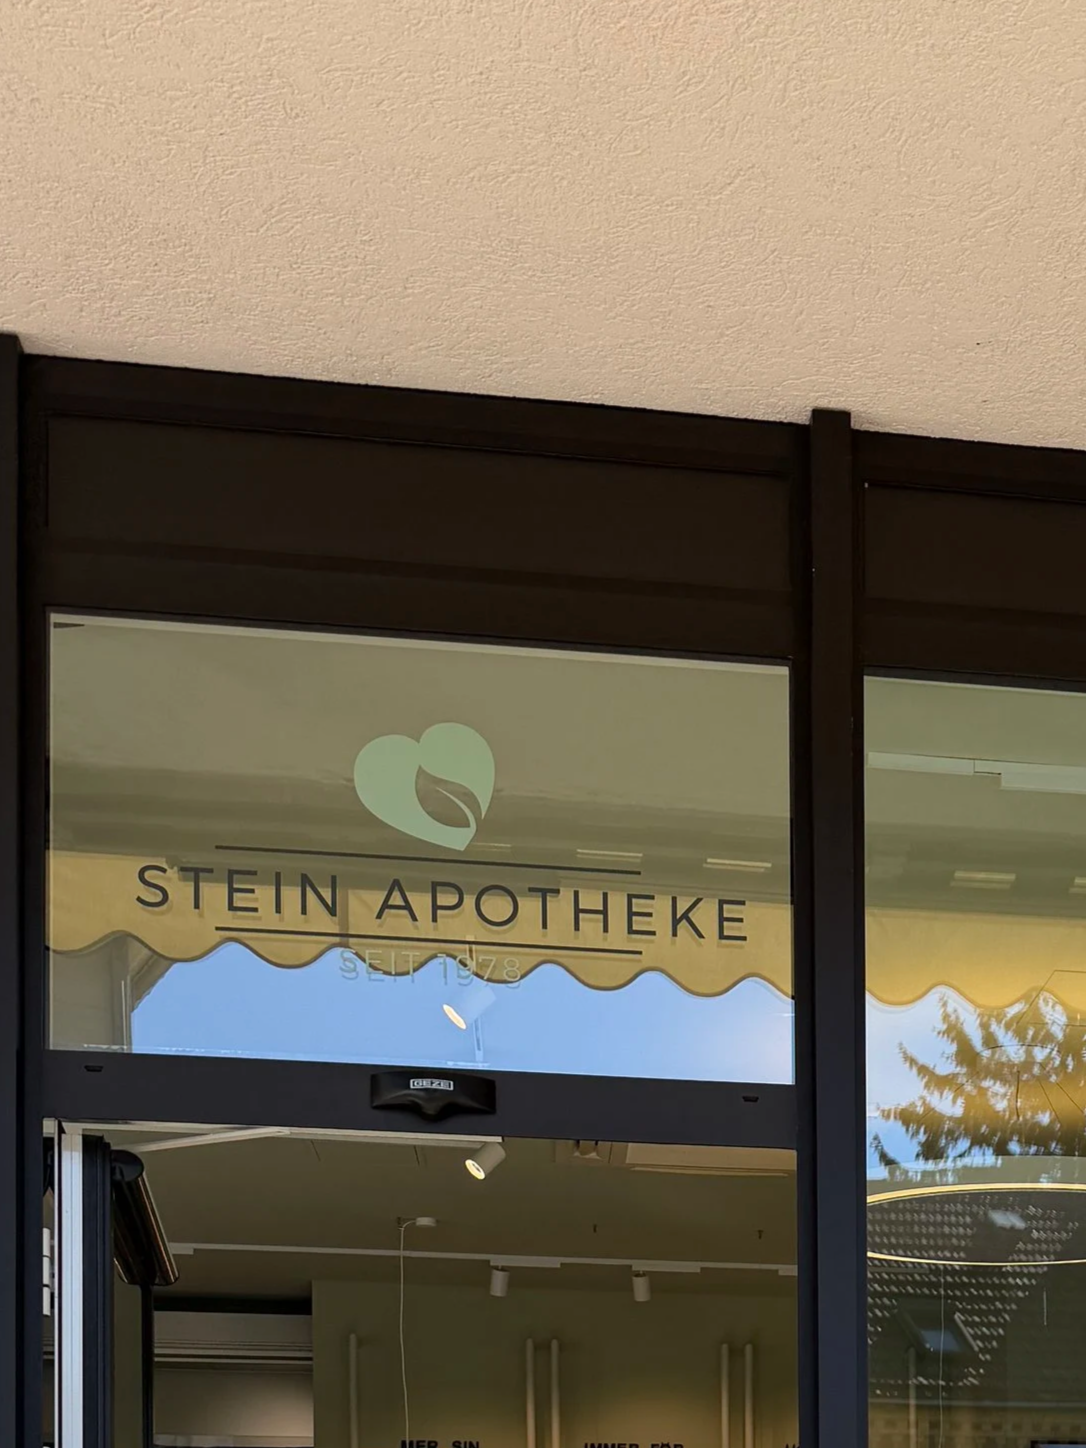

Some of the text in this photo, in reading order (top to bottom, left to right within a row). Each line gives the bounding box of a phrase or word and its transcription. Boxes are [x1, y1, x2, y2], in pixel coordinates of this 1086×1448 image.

[136, 864, 749, 941] STEIN APOTHEKE
[339, 949, 521, 982] SEIT 1978
